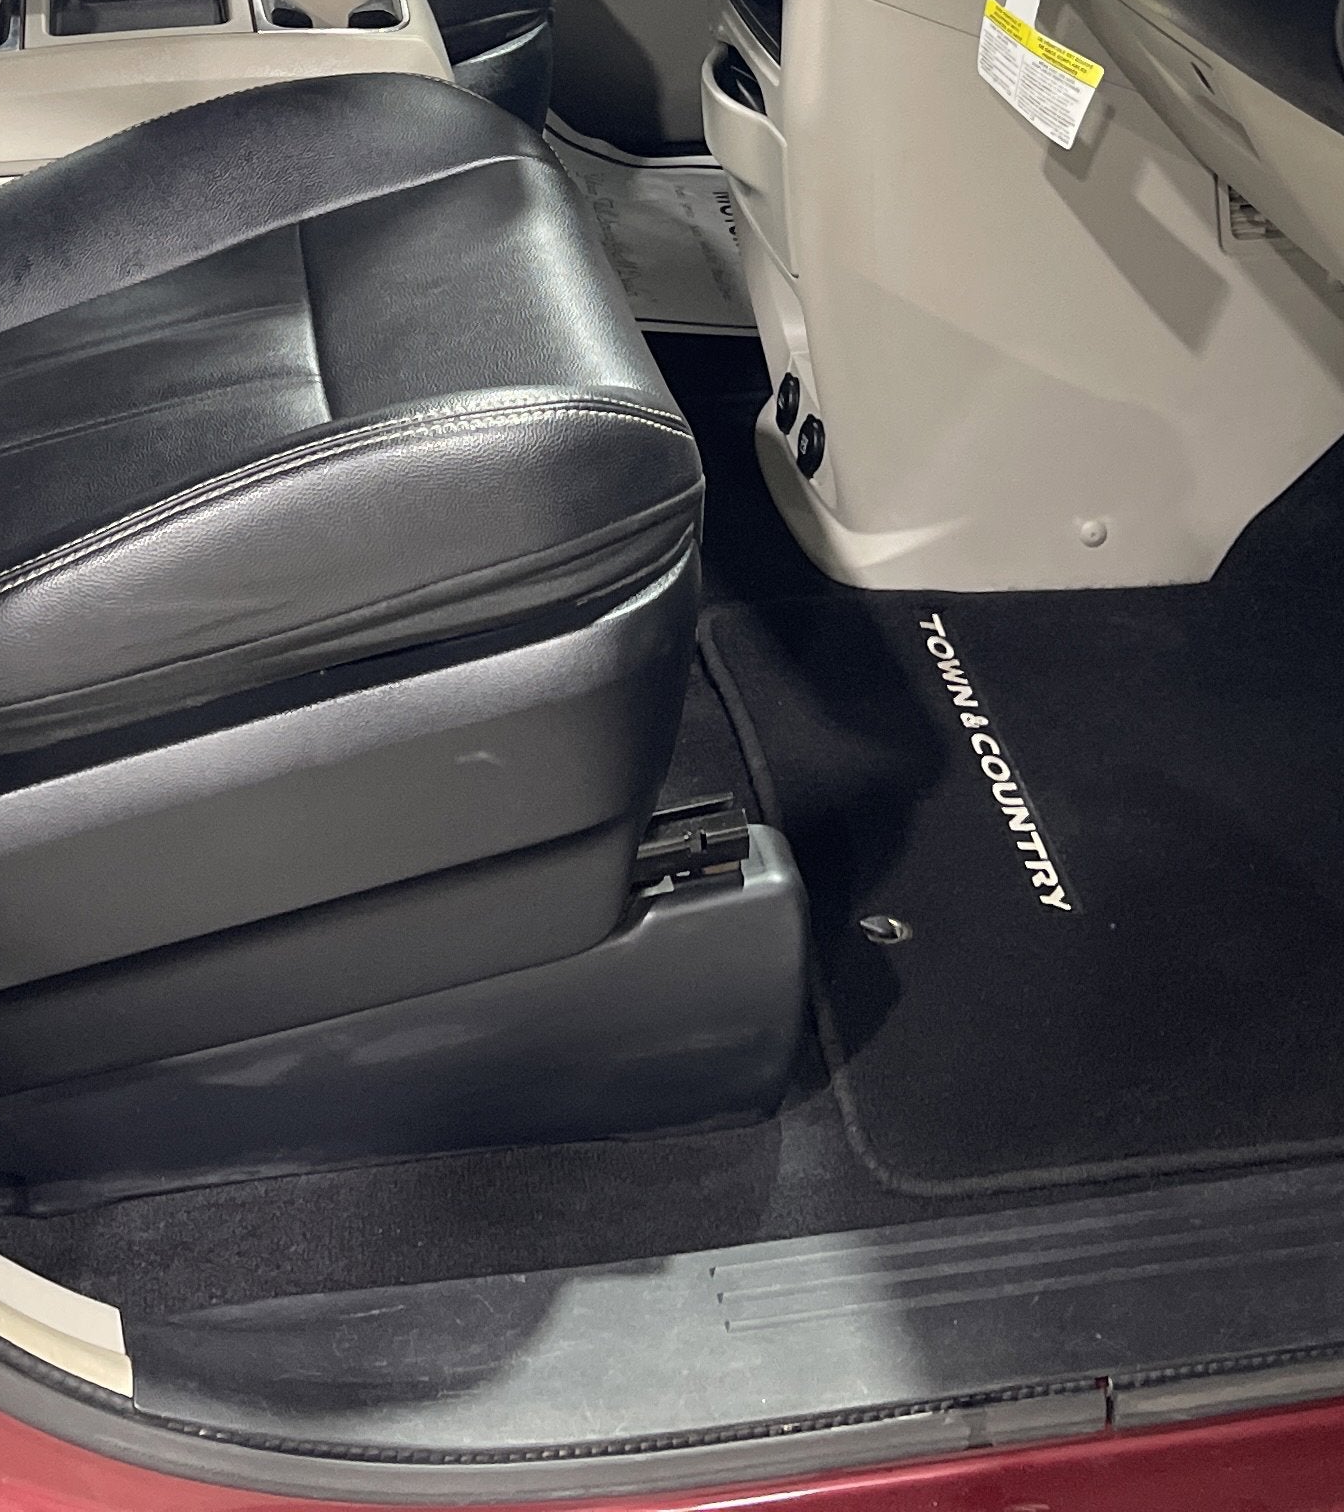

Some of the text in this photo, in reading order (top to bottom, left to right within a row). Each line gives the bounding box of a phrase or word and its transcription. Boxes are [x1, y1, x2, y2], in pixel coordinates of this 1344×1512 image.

[919, 613, 1073, 912] TOWN & COUNTRY
